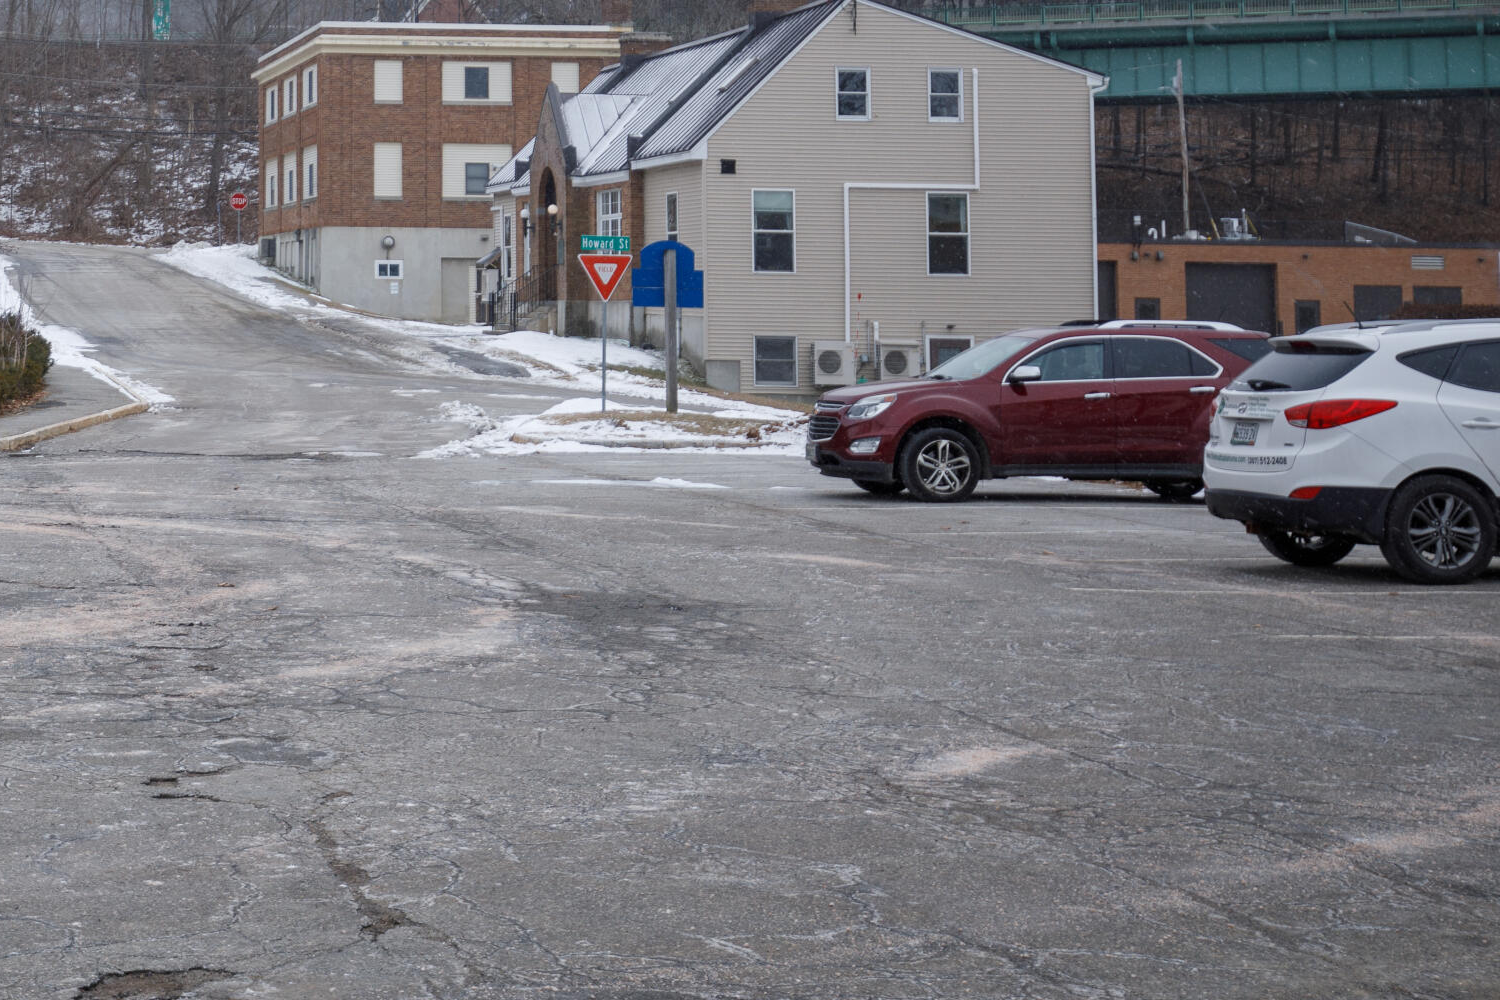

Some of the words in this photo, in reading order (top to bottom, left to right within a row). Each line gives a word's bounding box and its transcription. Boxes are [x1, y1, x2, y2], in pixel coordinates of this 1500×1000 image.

[231, 197, 247, 205] STOP
[582, 237, 614, 249] Howard
[619, 238, 629, 249] St
